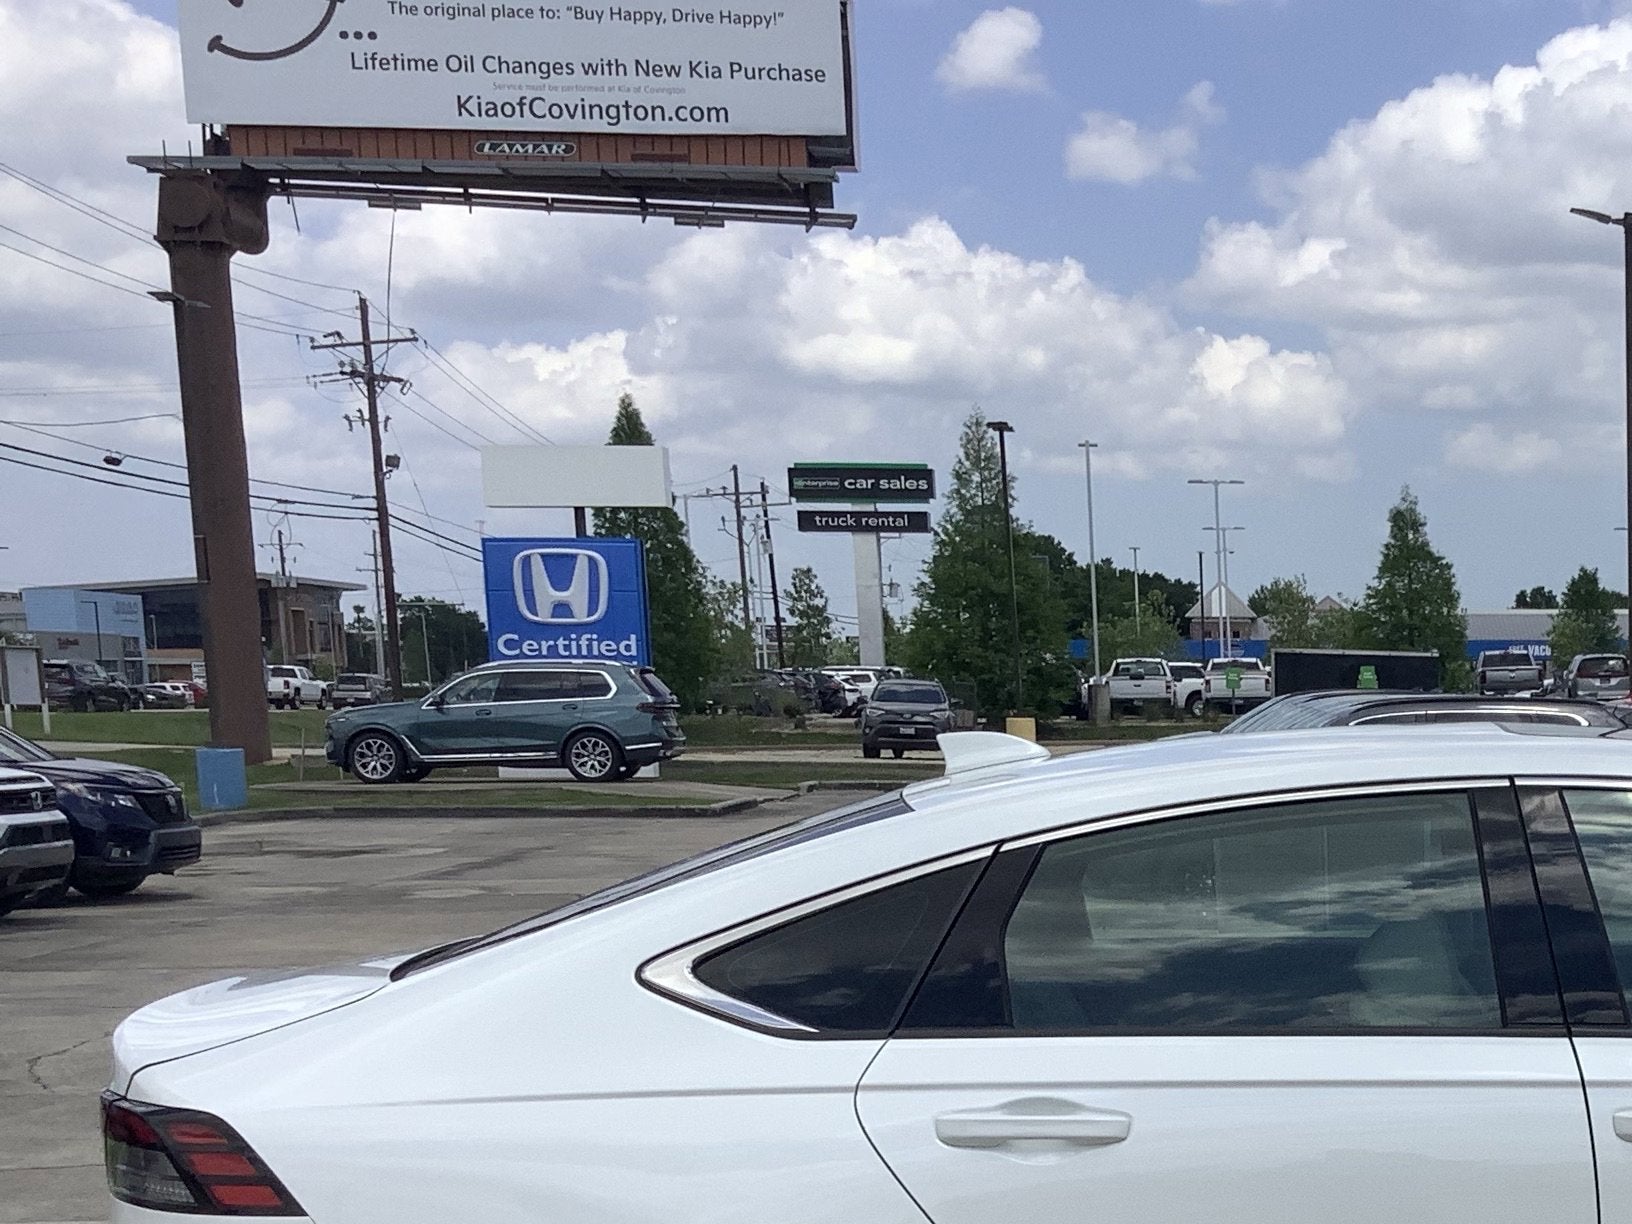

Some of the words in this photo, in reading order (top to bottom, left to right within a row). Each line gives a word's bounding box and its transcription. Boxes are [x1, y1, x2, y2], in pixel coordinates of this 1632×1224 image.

[387, 1, 418, 16] The
[424, 3, 486, 20] original
[491, 4, 534, 21] place
[539, 6, 561, 20] to:
[610, 7, 667, 25] Happy,
[672, 8, 714, 24] Drive
[351, 52, 438, 72] Lifetime
[445, 54, 475, 73] Oil
[482, 55, 575, 79] Changes
[581, 57, 627, 77] with
[635, 59, 682, 78] New
[688, 60, 722, 79] Kia
[729, 61, 826, 83] Purchase
[456, 95, 729, 126] KiaofCovington.com
[483, 142, 567, 155] LAMAR
[844, 479, 875, 490] car
[879, 475, 929, 490] sales
[814, 514, 856, 527] truck
[861, 514, 908, 527] rental
[497, 633, 638, 656] Certified
